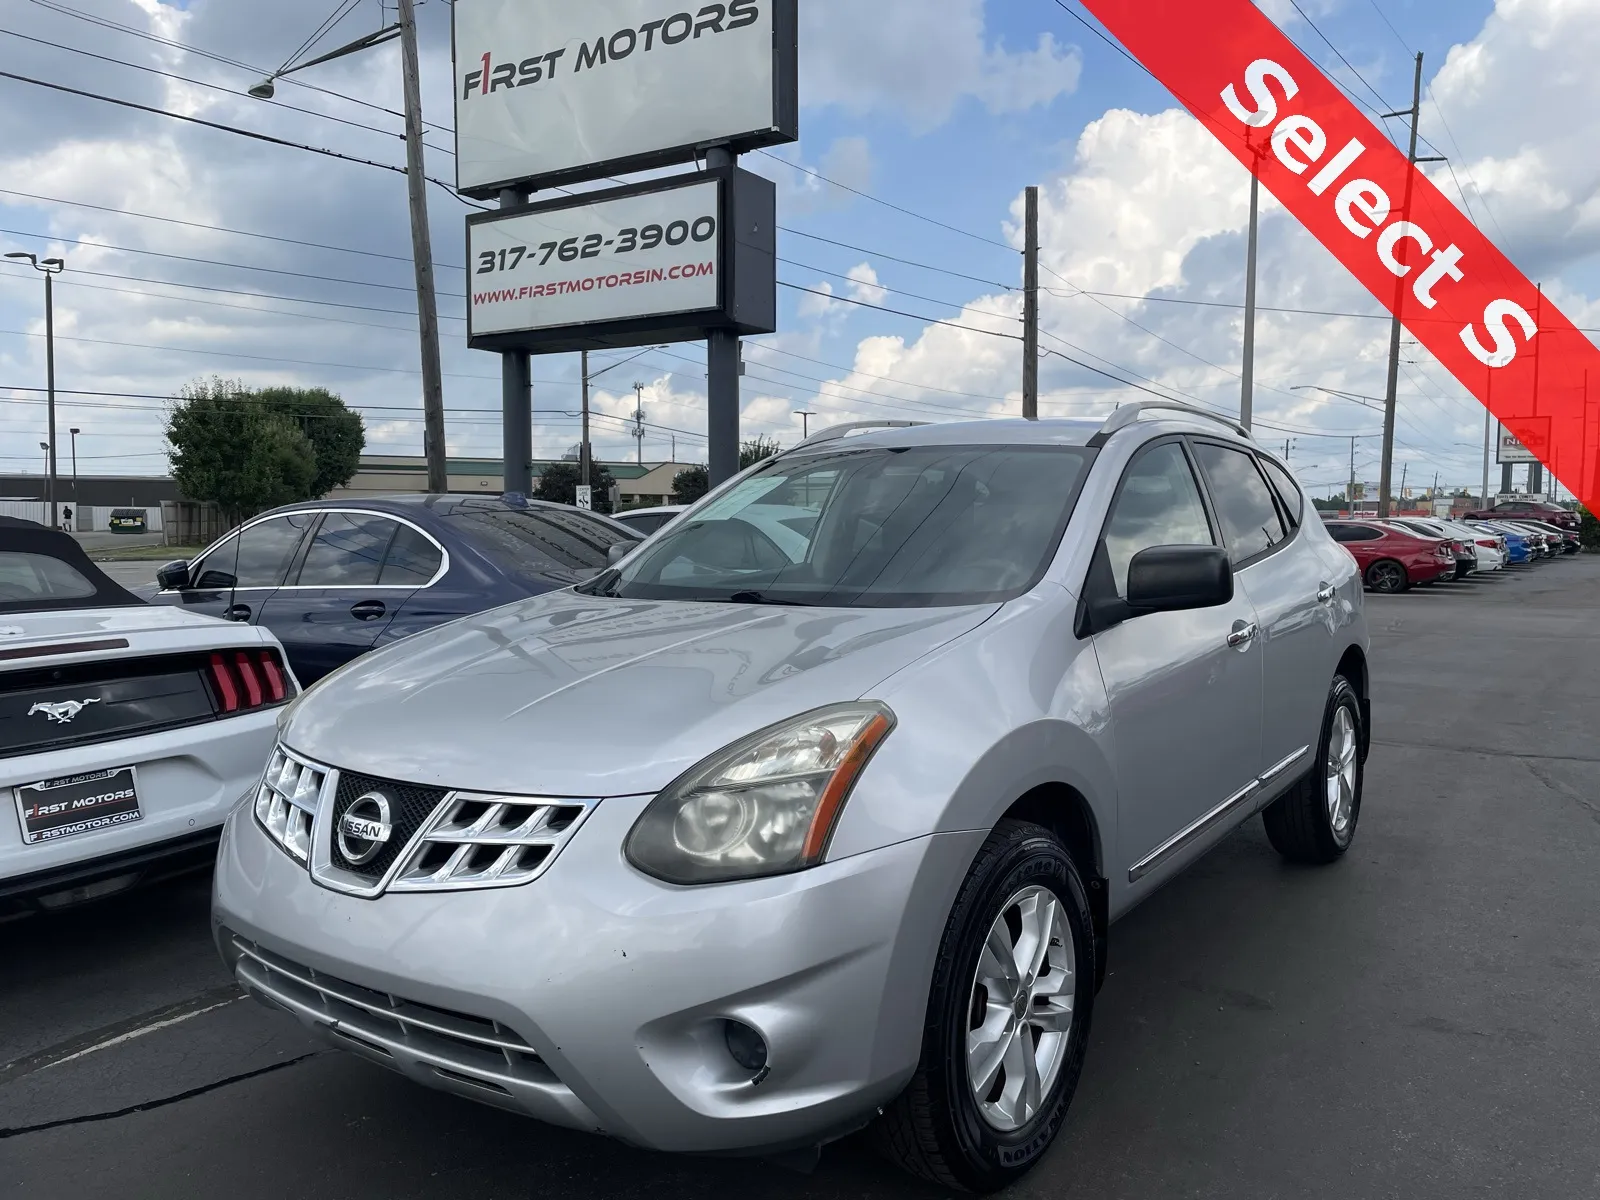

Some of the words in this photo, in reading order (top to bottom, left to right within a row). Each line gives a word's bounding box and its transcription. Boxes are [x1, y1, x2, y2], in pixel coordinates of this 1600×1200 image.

[573, 0, 759, 73] MOTORS
[476, 216, 716, 274] 317-762-3900
[473, 262, 714, 306] WWW.FIRSTMOTORSIN.COM
[71, 771, 107, 782] MOTORS
[72, 789, 134, 808] MOTORS
